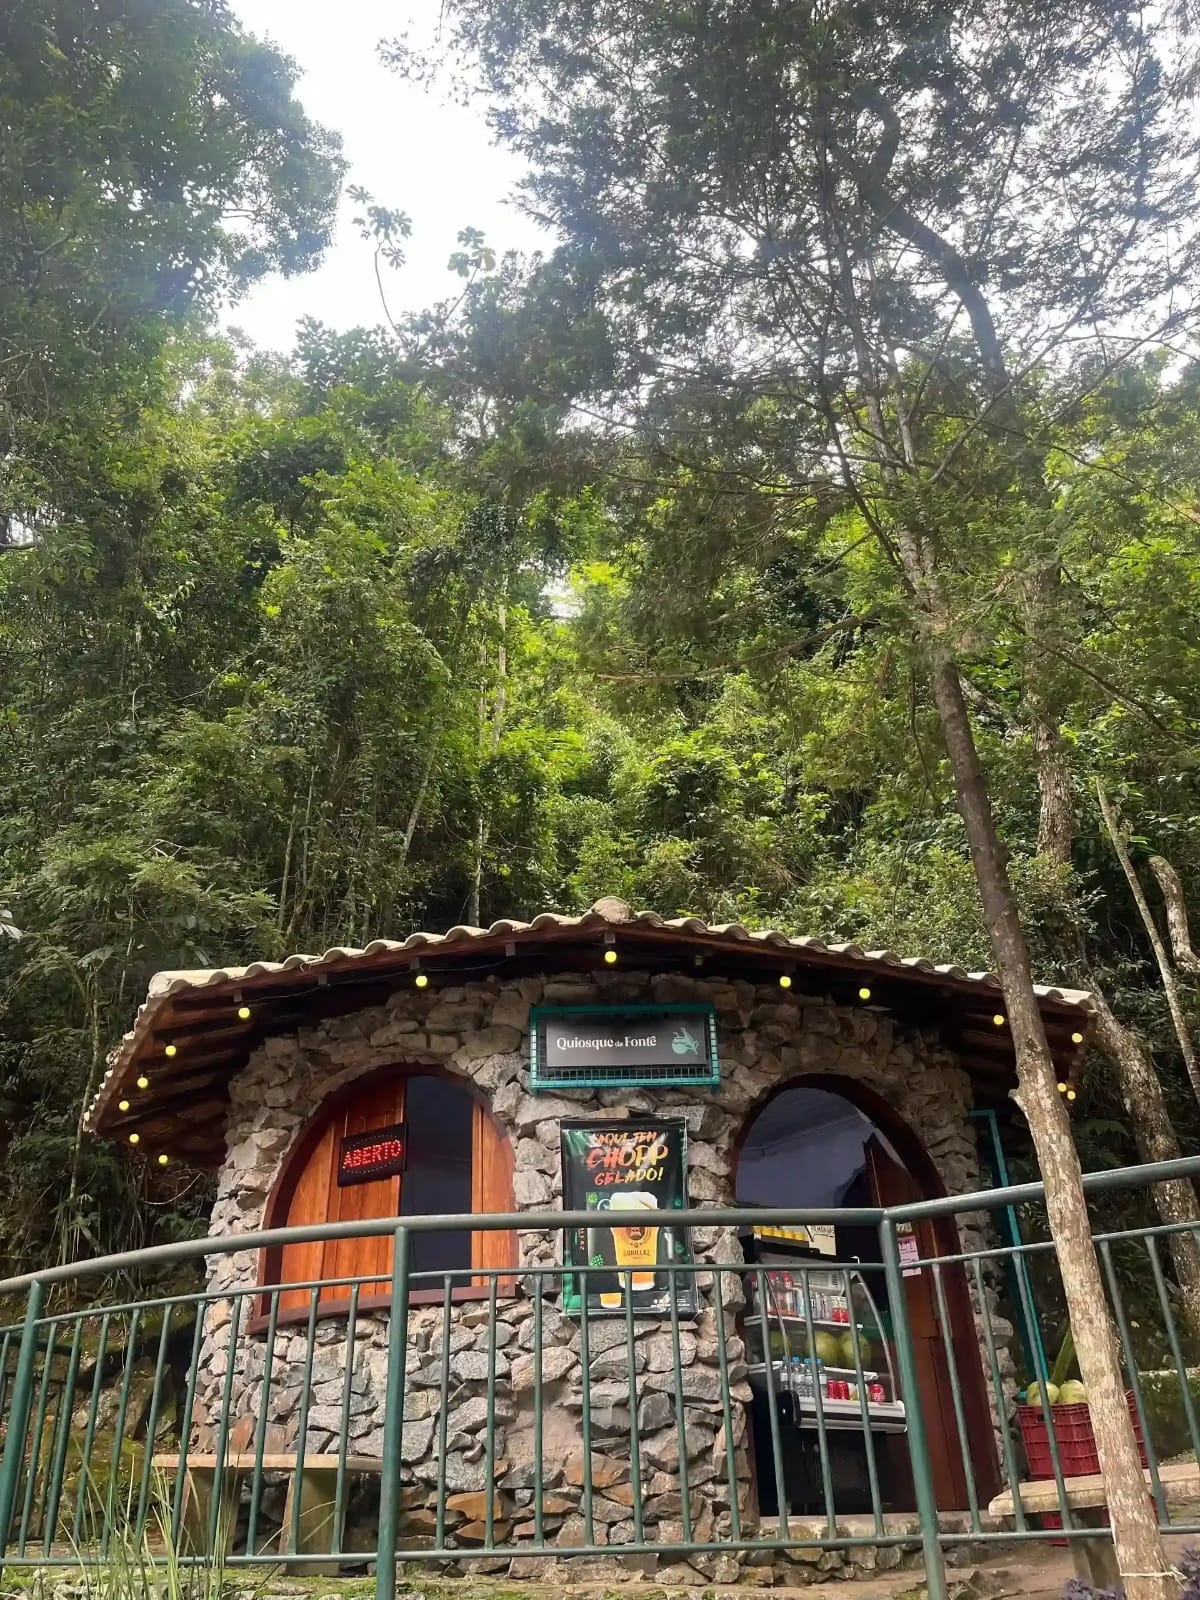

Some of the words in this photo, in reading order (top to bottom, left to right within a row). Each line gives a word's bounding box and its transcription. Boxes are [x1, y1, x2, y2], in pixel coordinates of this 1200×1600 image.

[556, 1036, 614, 1050] Quiosque
[597, 1132, 628, 1145] AQUI
[633, 1131, 658, 1142] TEM
[342, 1139, 401, 1169] ABERTO
[587, 1144, 669, 1170] CHOPP
[594, 1166, 664, 1186] GELADO!
